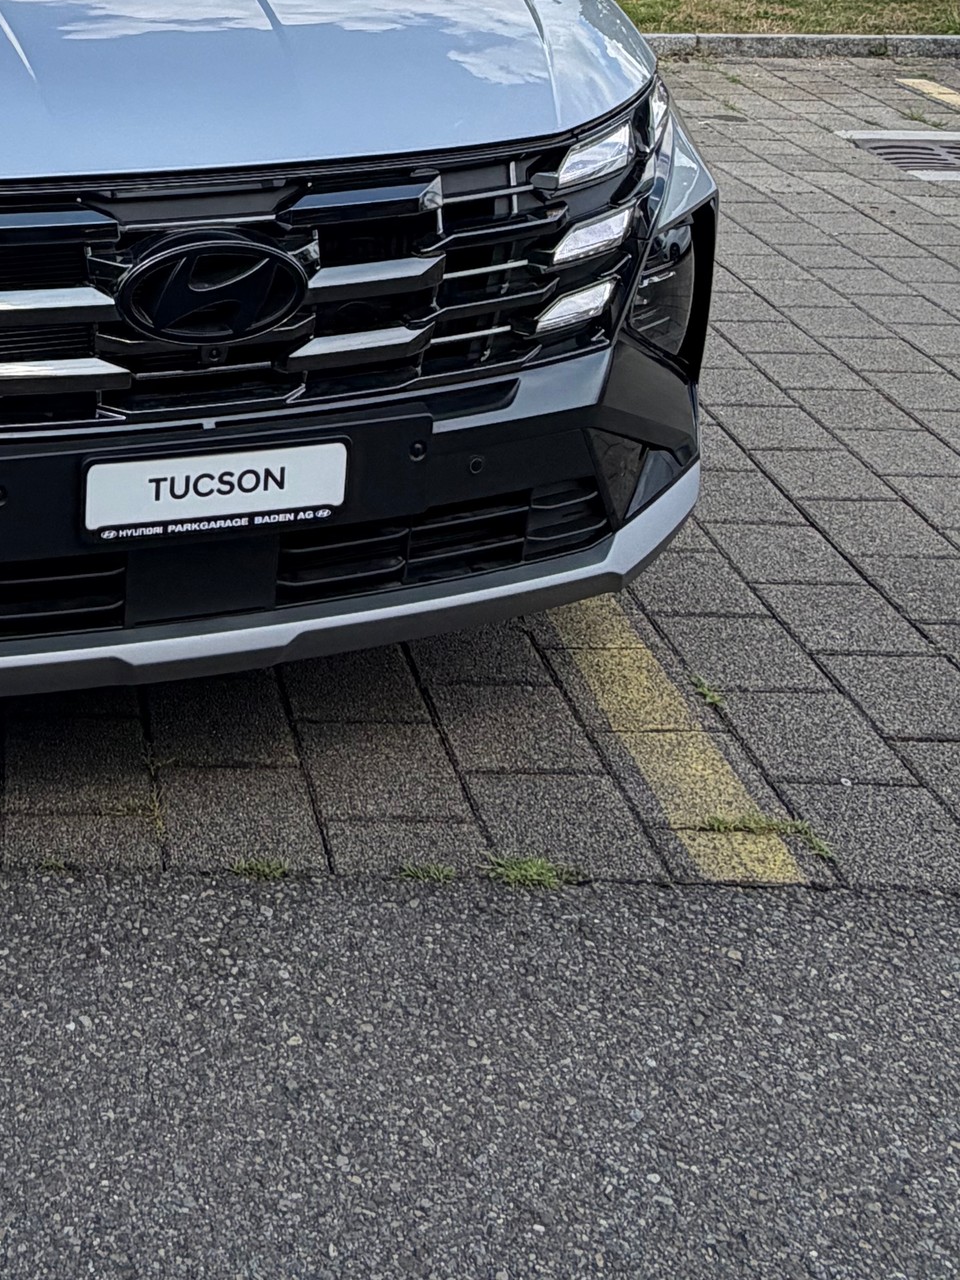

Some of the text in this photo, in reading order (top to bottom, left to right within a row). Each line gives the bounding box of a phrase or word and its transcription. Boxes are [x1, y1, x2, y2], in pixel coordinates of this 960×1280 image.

[148, 466, 286, 502] TUCSON
[119, 510, 314, 538] HYUNDAI PARKGARAGE BADEN AG
